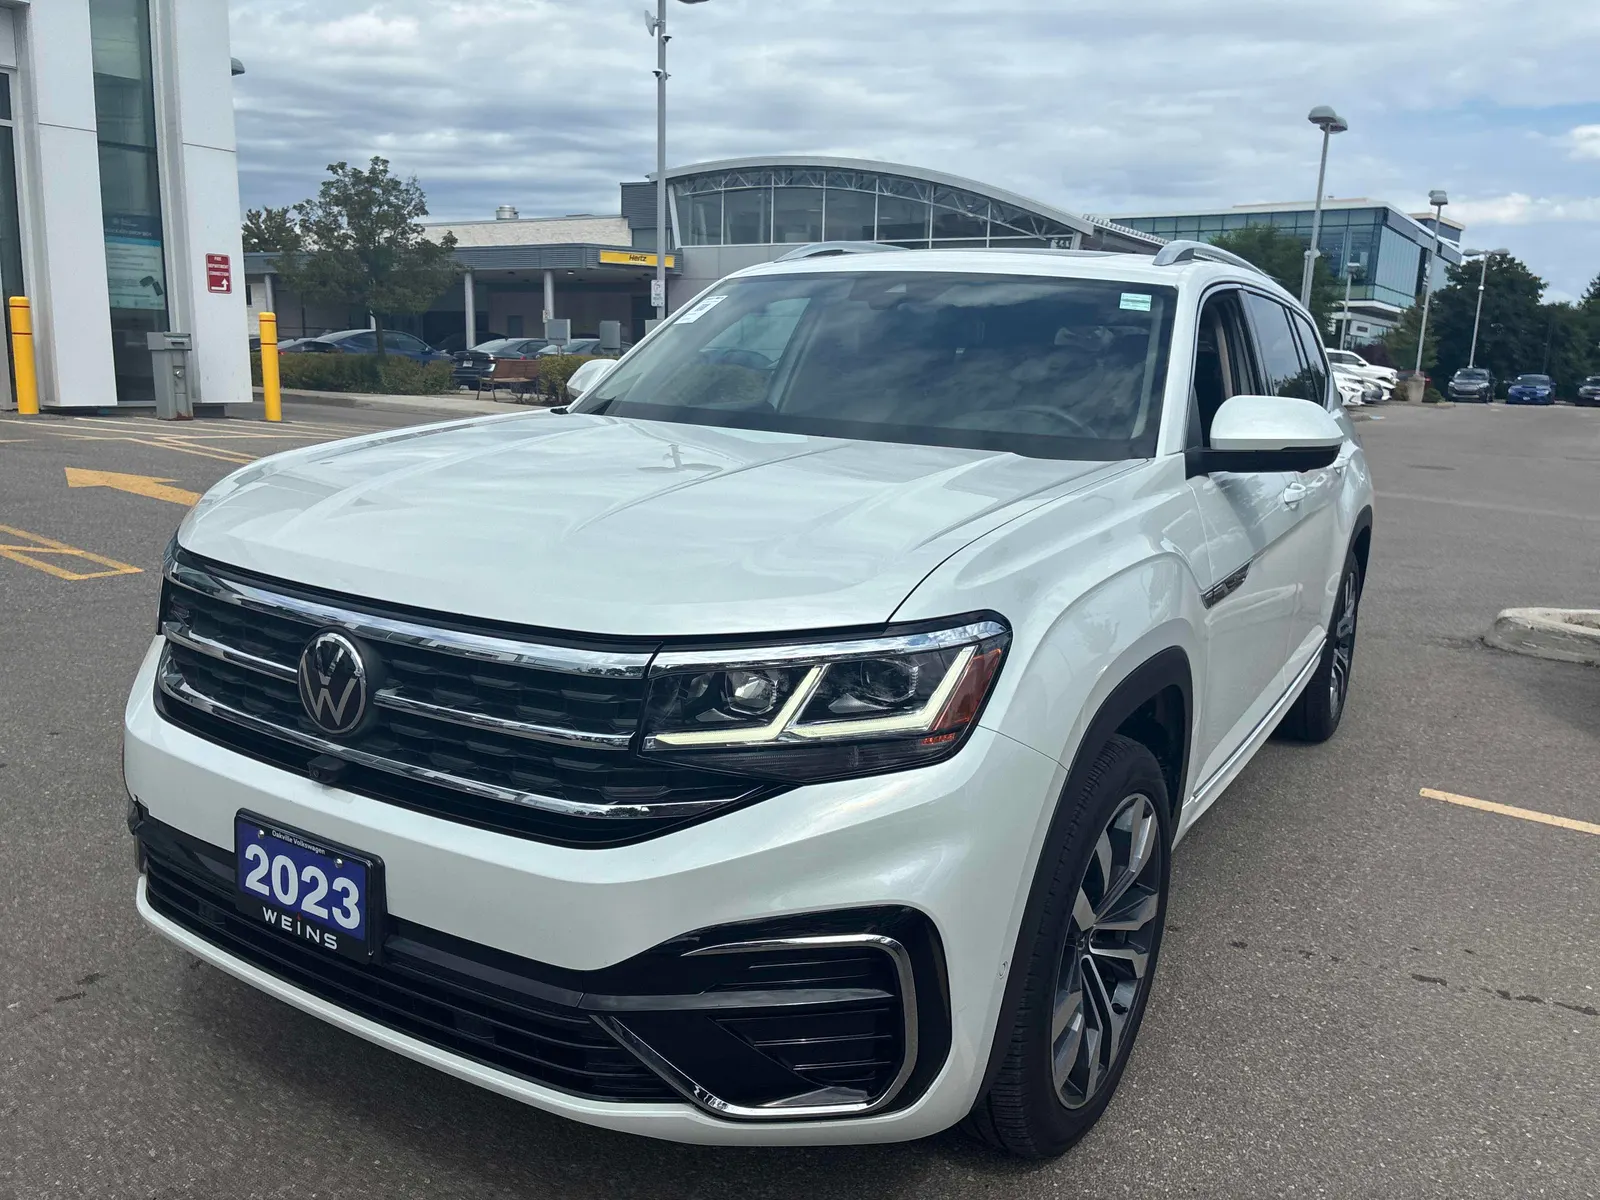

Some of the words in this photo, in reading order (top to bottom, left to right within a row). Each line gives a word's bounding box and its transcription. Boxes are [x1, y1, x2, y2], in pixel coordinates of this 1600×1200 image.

[272, 829, 293, 844] Oakville
[293, 837, 326, 855] Volkswagen
[245, 843, 361, 930] 2023
